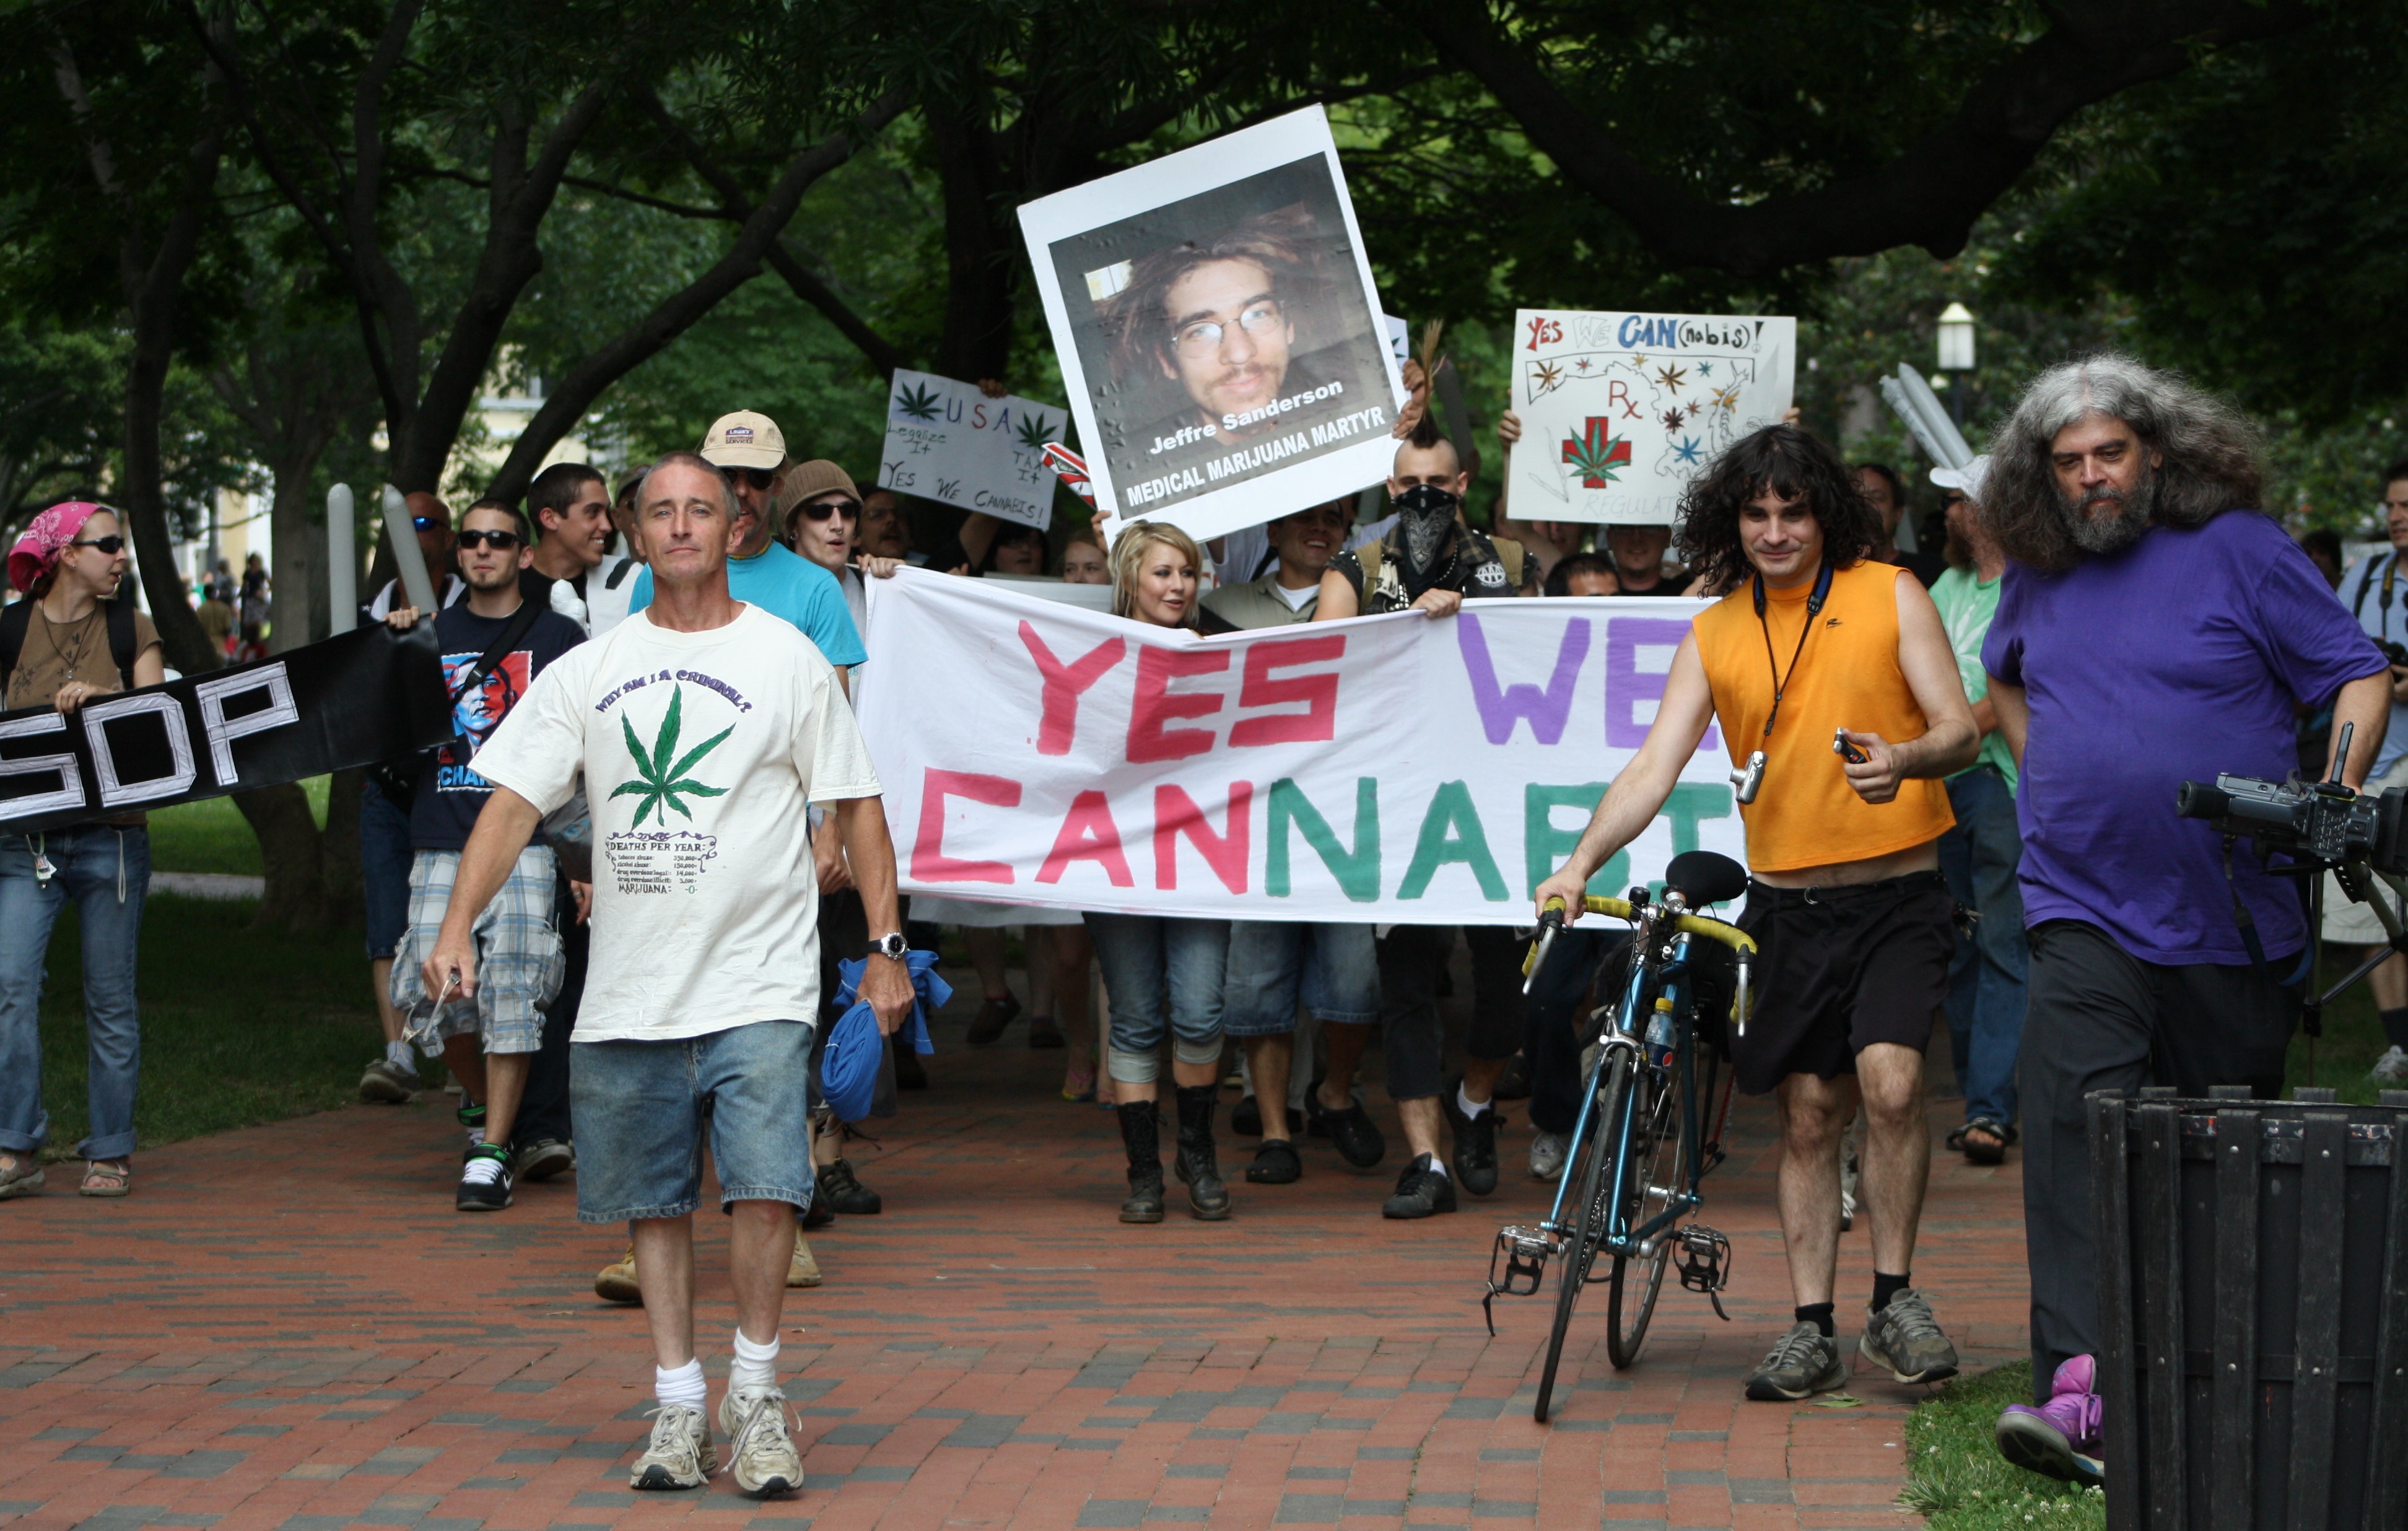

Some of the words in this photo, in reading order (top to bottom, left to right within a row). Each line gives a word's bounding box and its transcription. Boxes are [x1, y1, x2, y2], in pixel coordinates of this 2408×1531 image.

[1525, 316, 1563, 352] YES
[1572, 315, 1610, 348] WE
[1149, 422, 1217, 455] Jeffre
[1222, 380, 1343, 431] Sanderson
[1608, 380, 1643, 420] Rx
[887, 419, 947, 443] Legalize
[909, 440, 931, 455] It
[1013, 450, 1044, 471] TAX
[1126, 466, 1205, 507] MEDICAL
[1206, 431, 1311, 481] MARIJUANA
[1310, 406, 1386, 447] MARTYR
[884, 460, 915, 488] YES
[938, 478, 961, 499] WE
[974, 490, 1044, 525] CANNABIS!
[1018, 468, 1041, 485] It
[1581, 494, 1677, 518] REGULAT
[595, 686, 622, 713] WHY
[622, 676, 648, 694] AM
[650, 673, 657, 685] I
[658, 669, 673, 681] A
[676, 669, 753, 714] CRIMINAL?
[1018, 619, 1347, 764] YES
[1456, 612, 1718, 751] WE
[610, 842, 647, 851] DEATHS
[650, 842, 671, 851] PER
[674, 843, 706, 852] YEAR:
[910, 766, 1748, 909] CANNABI
